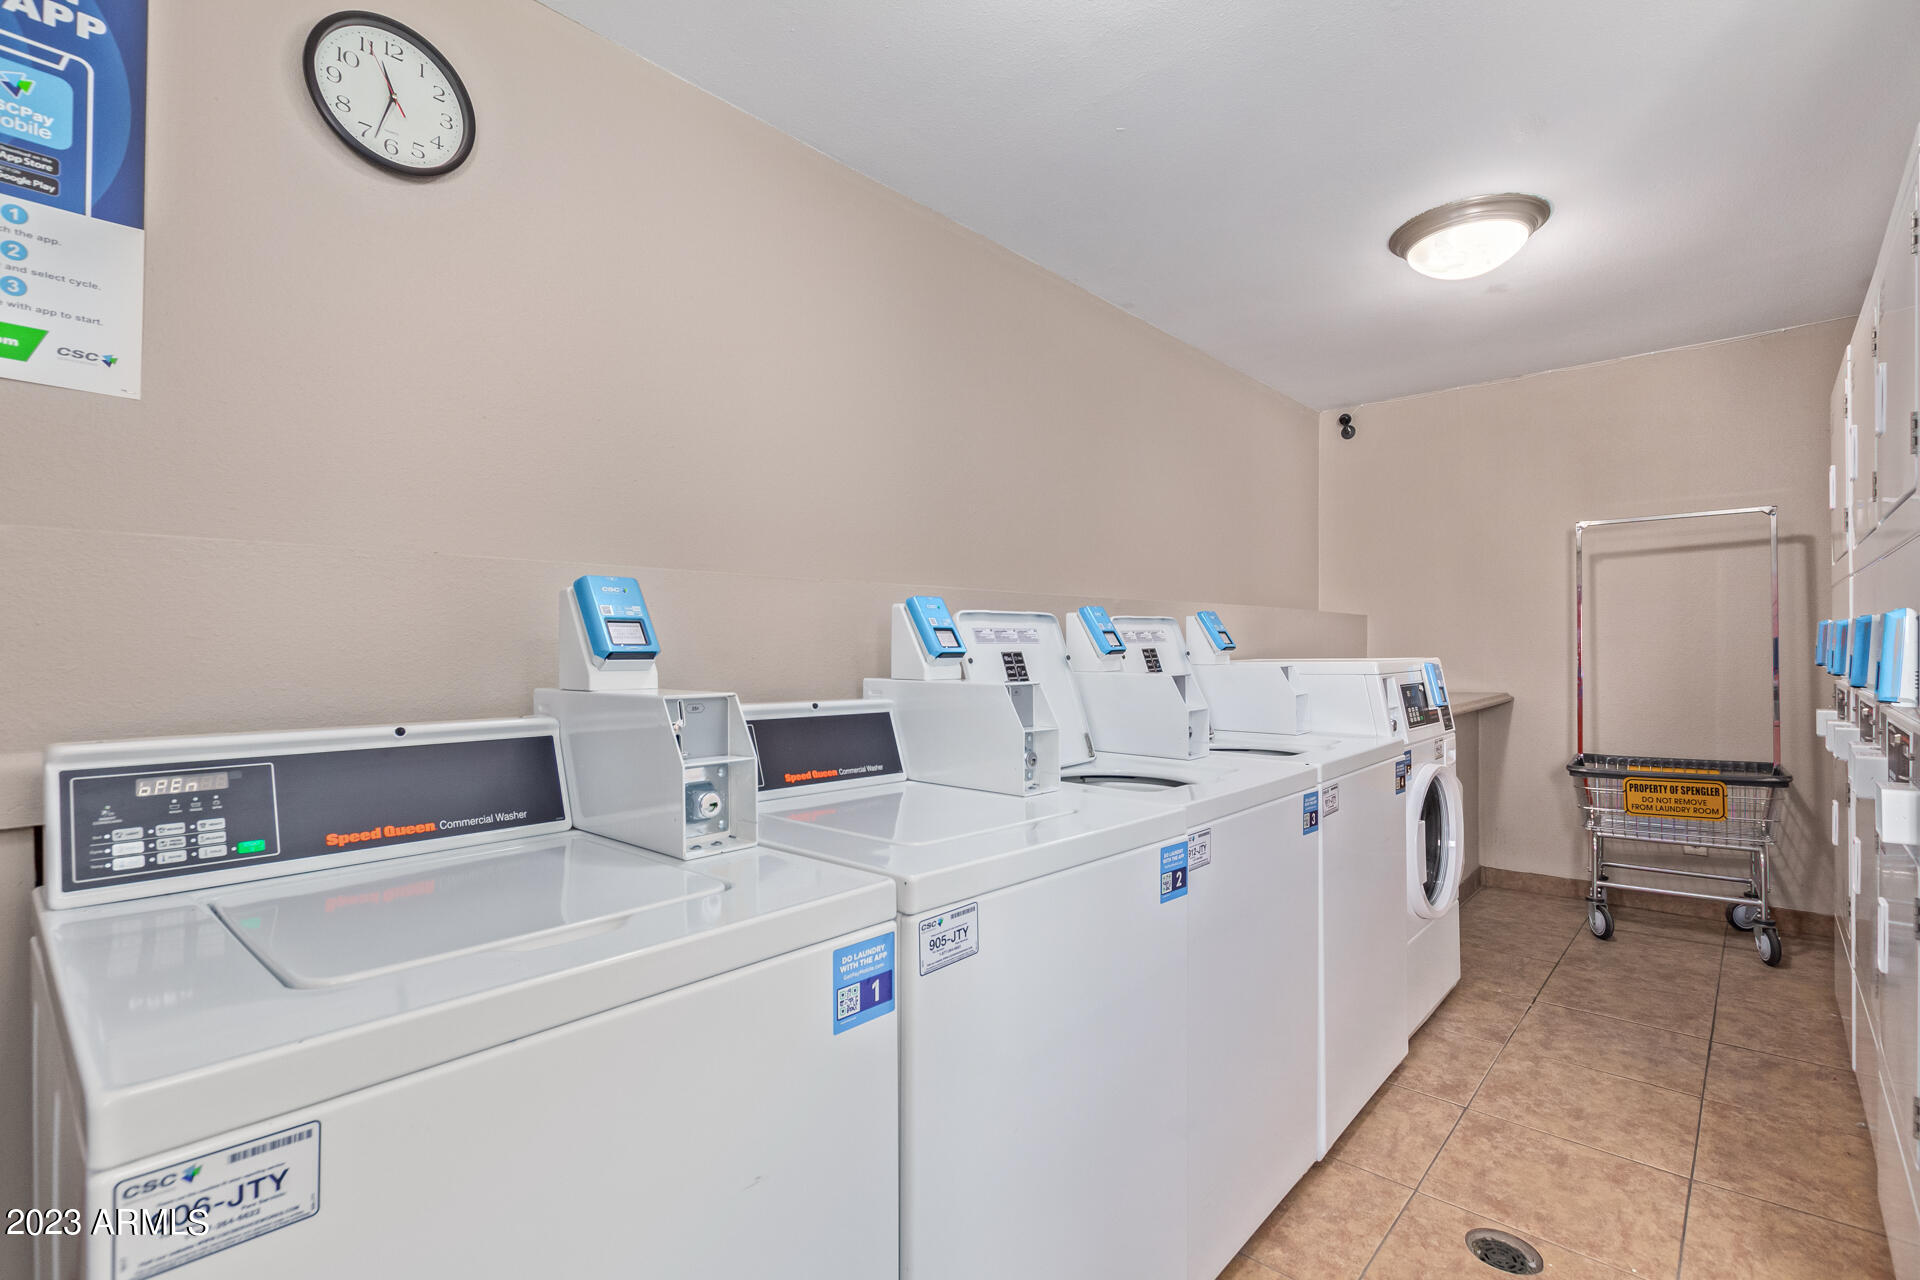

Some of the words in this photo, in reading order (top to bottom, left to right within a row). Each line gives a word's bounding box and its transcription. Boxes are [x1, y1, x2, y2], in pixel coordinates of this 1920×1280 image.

[2, 0, 107, 39] APP
[359, 36, 374, 56] 11
[384, 41, 404, 62] 12
[337, 46, 360, 69] 10
[326, 65, 342, 84] 9
[419, 63, 425, 78] 1
[433, 85, 446, 103] 2
[335, 94, 351, 113] 8
[358, 121, 373, 137] 7
[439, 113, 453, 130] 3
[384, 138, 399, 156] 6
[411, 142, 425, 159] 5
[430, 136, 444, 150] 4
[23, 157, 53, 172] Store
[32, 180, 56, 193] Play
[8, 207, 19, 221] 1
[14, 229, 33, 240] the
[36, 235, 62, 246] app.
[7, 243, 20, 258] 2
[5, 264, 28, 274] and
[31, 270, 66, 283] select
[69, 278, 102, 291] cycle.
[7, 279, 20, 293] 3
[6, 301, 32, 312] with
[35, 307, 57, 317] app
[60, 311, 72, 320] to
[75, 315, 103, 326] start.
[57, 347, 100, 361] CSC
[784, 773, 812, 783] Speed
[812, 769, 838, 779] Queen
[838, 766, 867, 776] Commercial
[1629, 783, 1668, 794] PROPERTY
[1669, 785, 1679, 795] OF
[1680, 785, 1720, 797] SPENGLER
[1631, 803, 1653, 811] FROM
[1655, 804, 1691, 813] LAUNDRY
[1693, 806, 1720, 815] ROOM
[1656, 797, 1672, 805] NOT
[1674, 798, 1707, 806] REMOVE
[1311, 812, 1316, 825] 3
[326, 826, 382, 847] Speed
[383, 822, 438, 838] Queen
[439, 814, 494, 830] Commercial
[495, 810, 528, 823] Washer
[1176, 871, 1183, 887] 2
[921, 920, 937, 931] CSC
[929, 925, 969, 951] 905-JTY
[840, 961, 859, 974] WITH
[860, 955, 873, 967] THE
[874, 951, 888, 963] APP
[841, 956, 853, 965] DO
[853, 944, 886, 960] LAUNDRY
[872, 978, 880, 1002] 1
[122, 1173, 178, 1200] CSC
